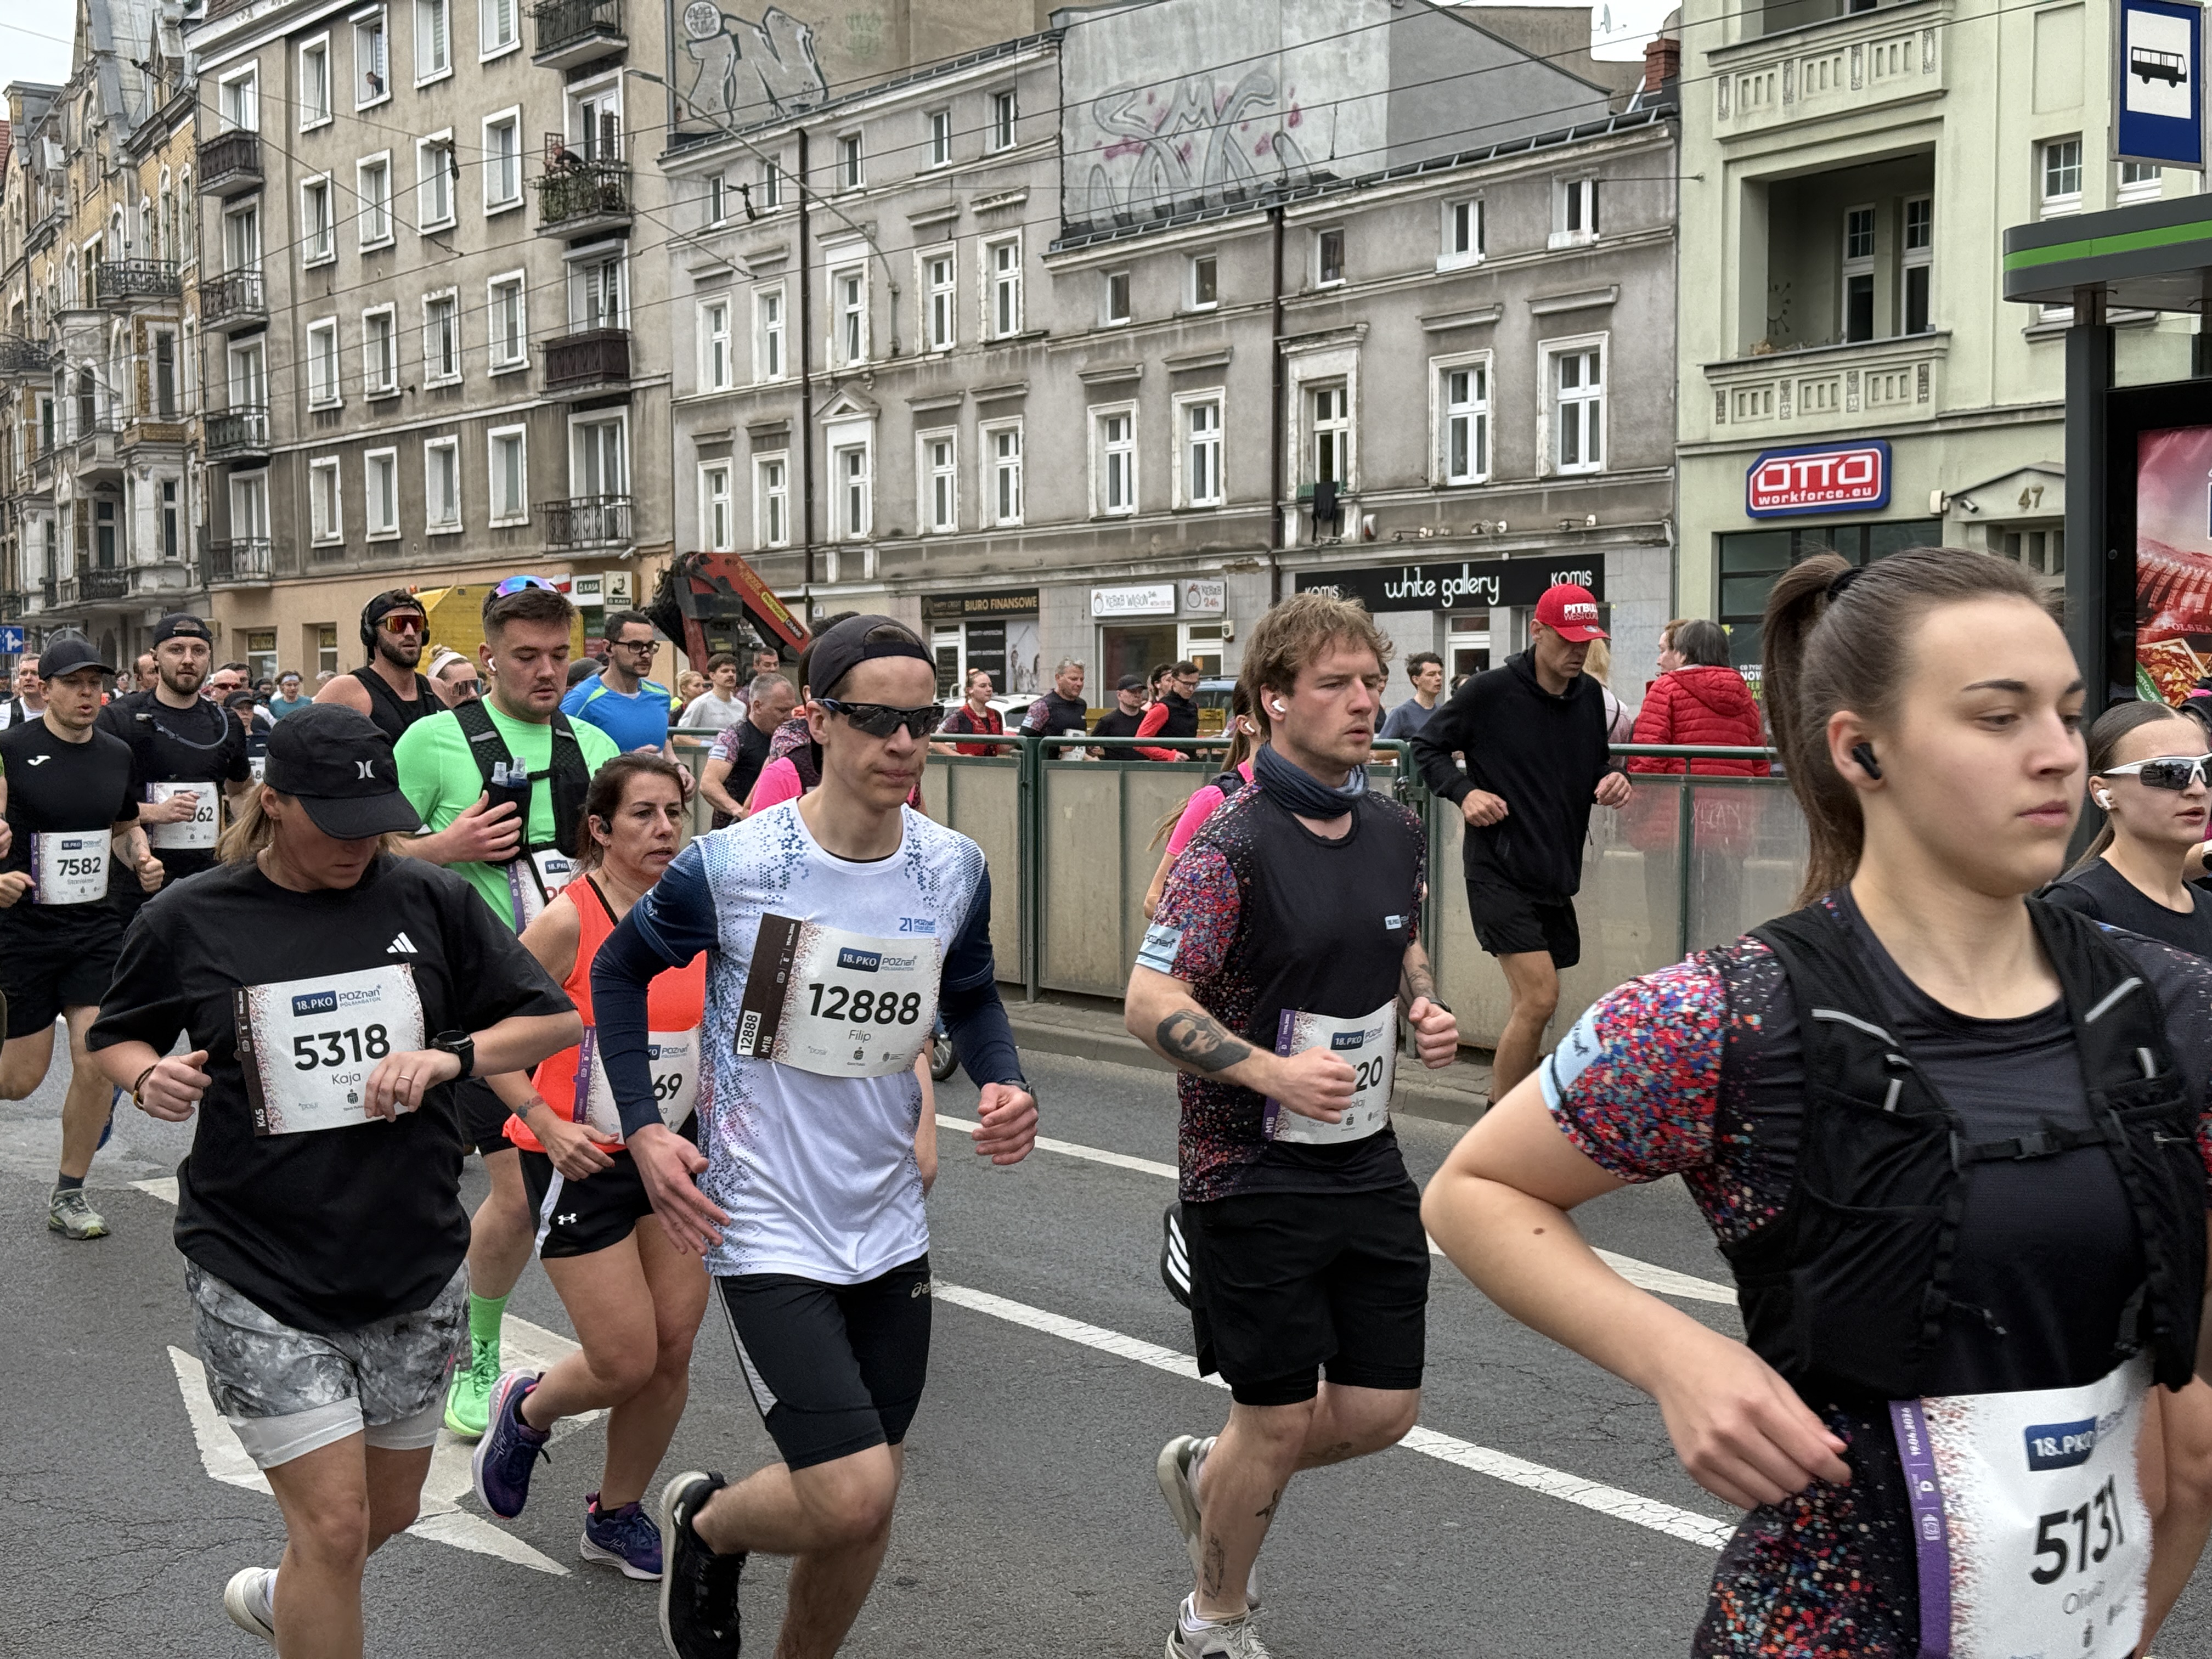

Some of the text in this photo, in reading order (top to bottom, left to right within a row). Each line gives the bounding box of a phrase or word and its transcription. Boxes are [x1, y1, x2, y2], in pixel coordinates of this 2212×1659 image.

[1757, 455, 1872, 492] OTTO
[1758, 486, 1872, 506] workforce.eu
[2017, 485, 2045, 510] 47
[1384, 563, 1500, 608] white gallery
[1550, 569, 1593, 589] KOMIS
[964, 595, 1037, 611] BIURO FINANSOWE
[1740, 670, 1762, 681] NOW
[57, 856, 101, 877] 7582
[899, 917, 912, 932] 21
[842, 953, 878, 967] 18.PKO
[295, 991, 334, 1012] 18.PKO
[808, 983, 922, 1025] 12888
[740, 1014, 759, 1051] 12888
[848, 1029, 872, 1043] Filip
[1334, 1035, 1363, 1046] 18.PKO
[293, 1024, 391, 1071] 5318
[760, 1035, 773, 1054] M18
[331, 1071, 362, 1086] Kaja
[1353, 1055, 1384, 1092] 20
[653, 1073, 683, 1102] 69
[255, 1108, 267, 1128] K45
